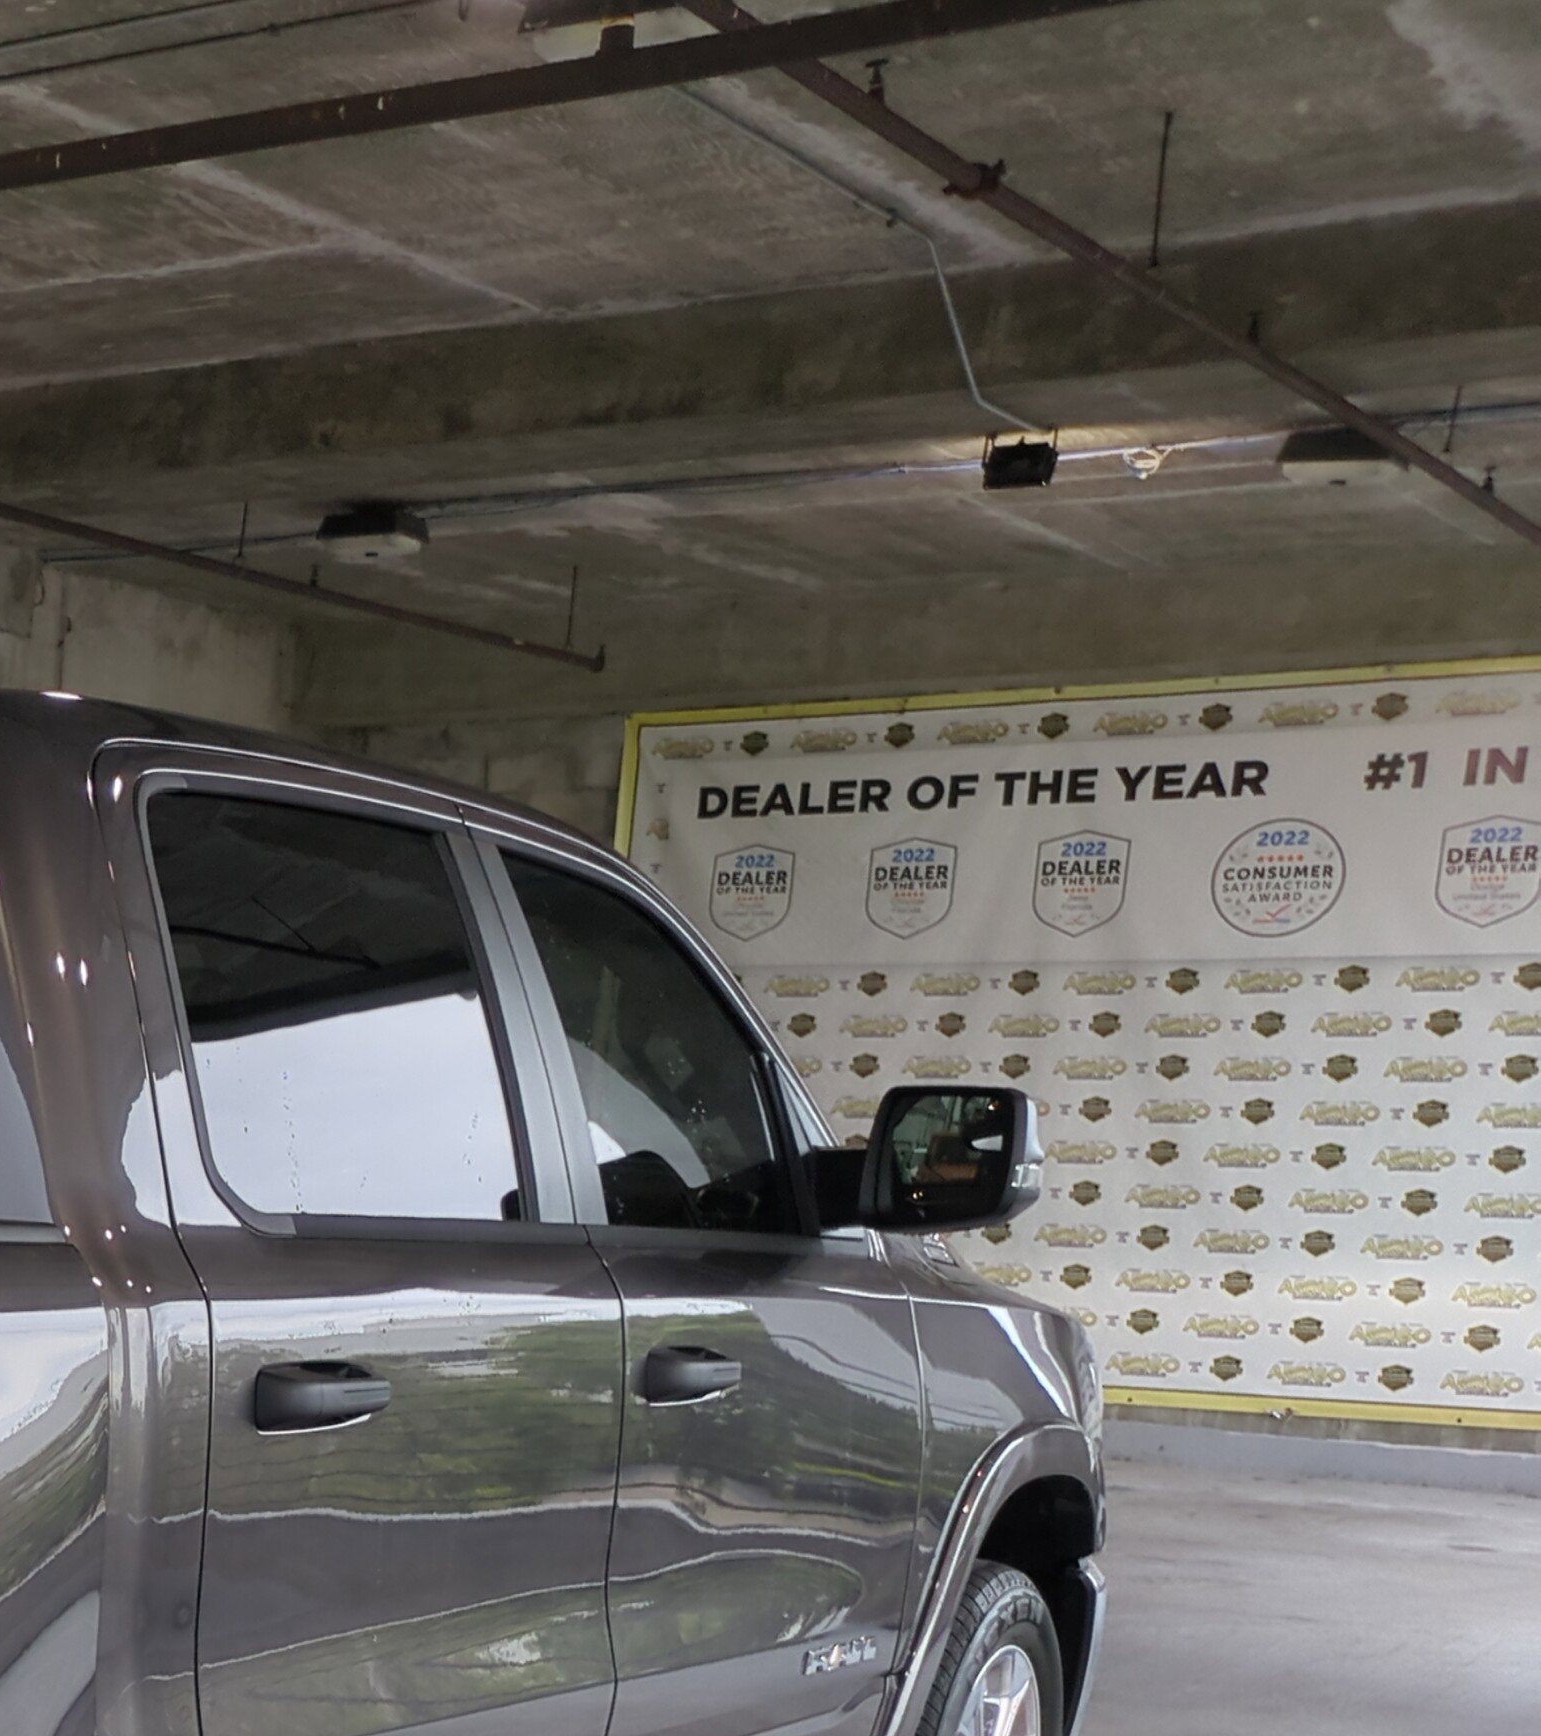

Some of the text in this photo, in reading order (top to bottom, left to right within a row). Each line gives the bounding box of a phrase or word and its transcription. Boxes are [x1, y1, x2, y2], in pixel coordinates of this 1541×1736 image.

[1364, 746, 1529, 790] #1 IN
[697, 760, 1269, 819] DEALER OF THE YEAR
[1256, 830, 1310, 846] 2022
[1470, 827, 1523, 843] 2022
[891, 849, 936, 863] 2022
[1061, 841, 1107, 856] 2022
[1446, 845, 1538, 864] DEALER
[734, 854, 776, 868] 2022
[1041, 859, 1121, 876] DEALER
[1503, 862, 1537, 872] YEAR
[717, 870, 788, 887] DEALER
[874, 865, 948, 881] DEALER
[1090, 875, 1120, 885] YEAR
[1223, 865, 1333, 881] CONSUMER
[1222, 880, 1332, 893] SATISFACTION
[1247, 891, 1303, 903] AWARD
